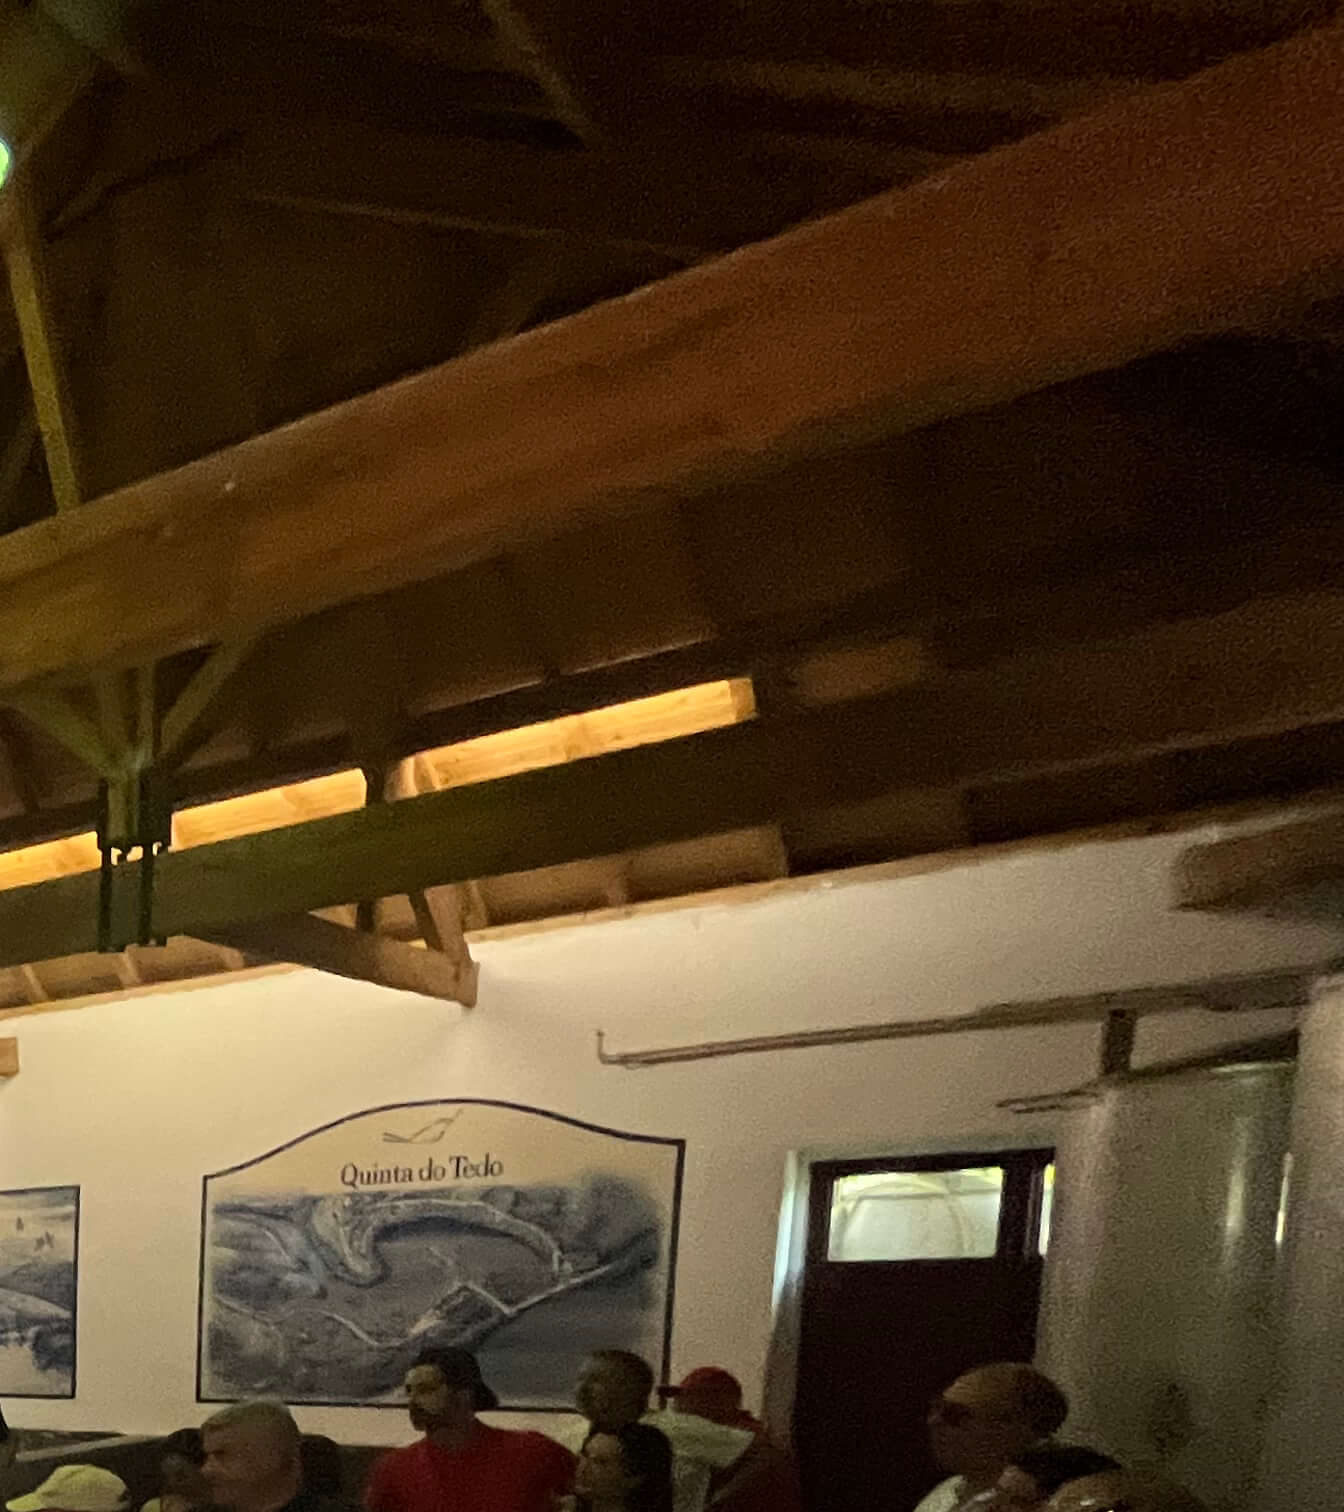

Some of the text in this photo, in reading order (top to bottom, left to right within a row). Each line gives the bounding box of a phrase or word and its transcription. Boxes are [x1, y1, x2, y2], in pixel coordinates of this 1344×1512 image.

[341, 1152, 504, 1189] Quinta do Tedo
